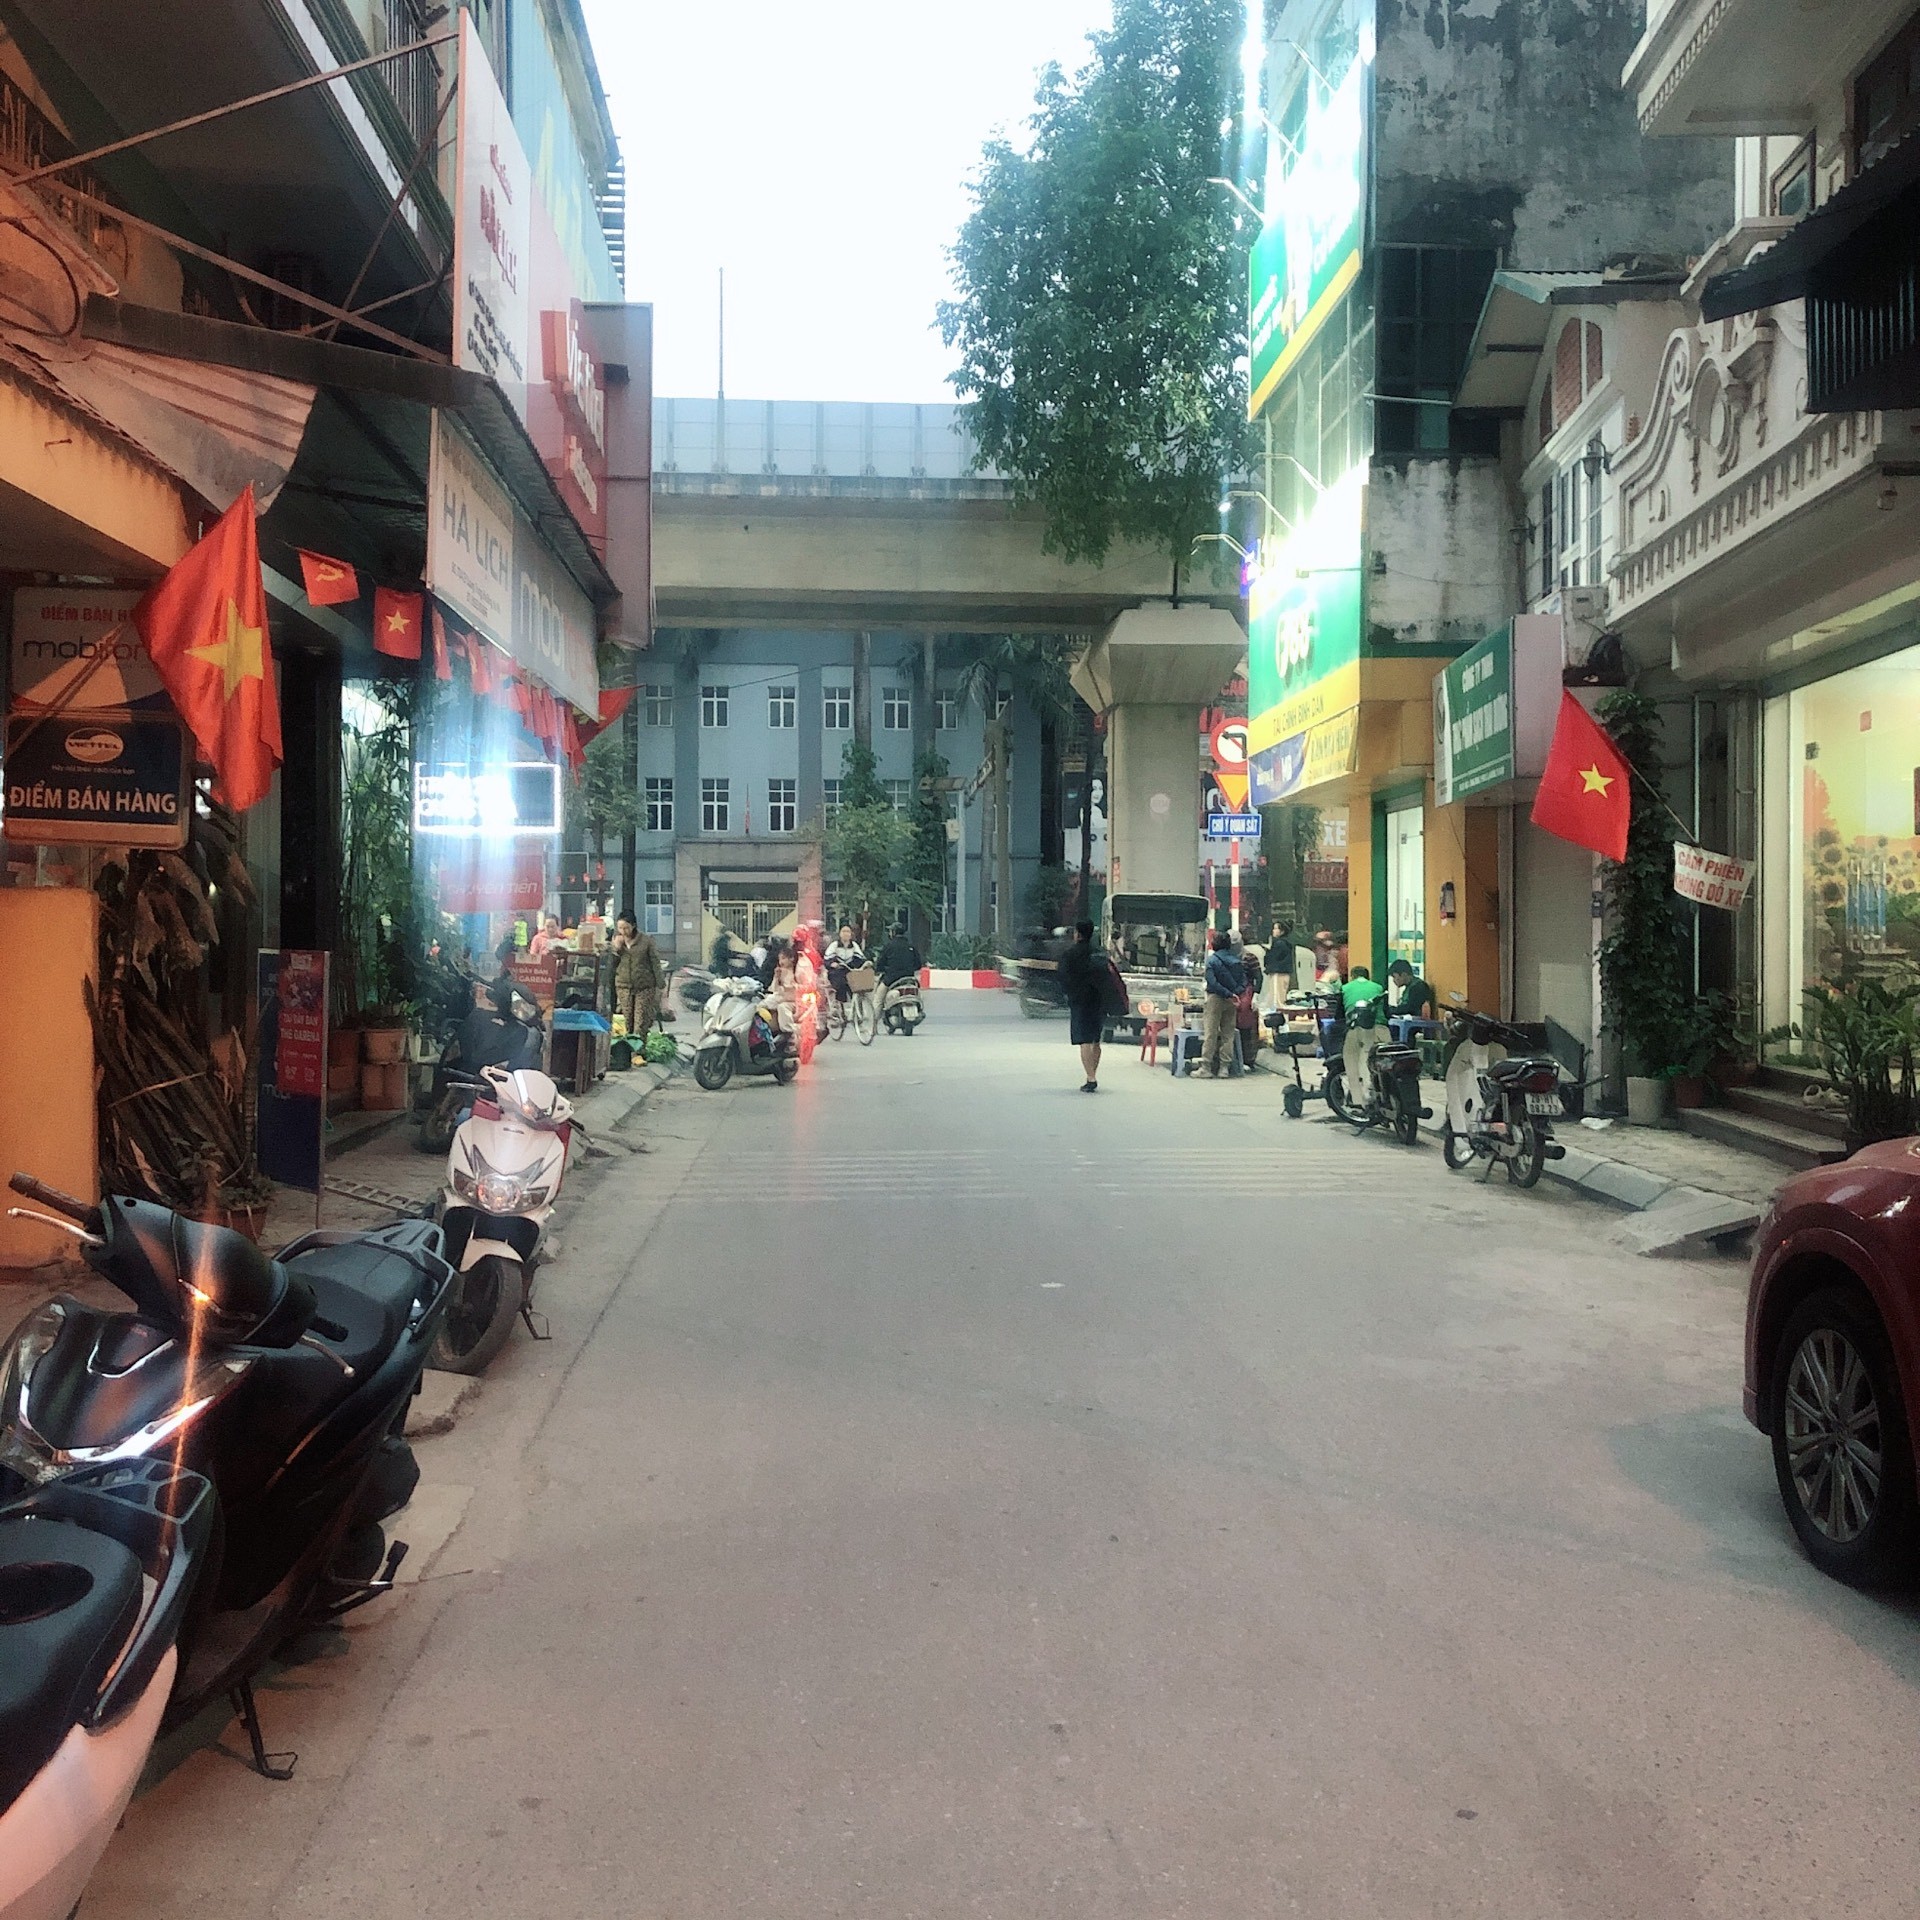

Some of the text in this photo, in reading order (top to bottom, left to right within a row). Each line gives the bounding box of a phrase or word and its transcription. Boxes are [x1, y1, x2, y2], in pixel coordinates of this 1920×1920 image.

[443, 482, 470, 553] HÀ
[68, 741, 119, 750] VIETTEL
[9, 779, 176, 814] ĐIỂM BÁN HÀNG
[1230, 819, 1246, 834] QUAN
[1246, 817, 1258, 832] SÁT
